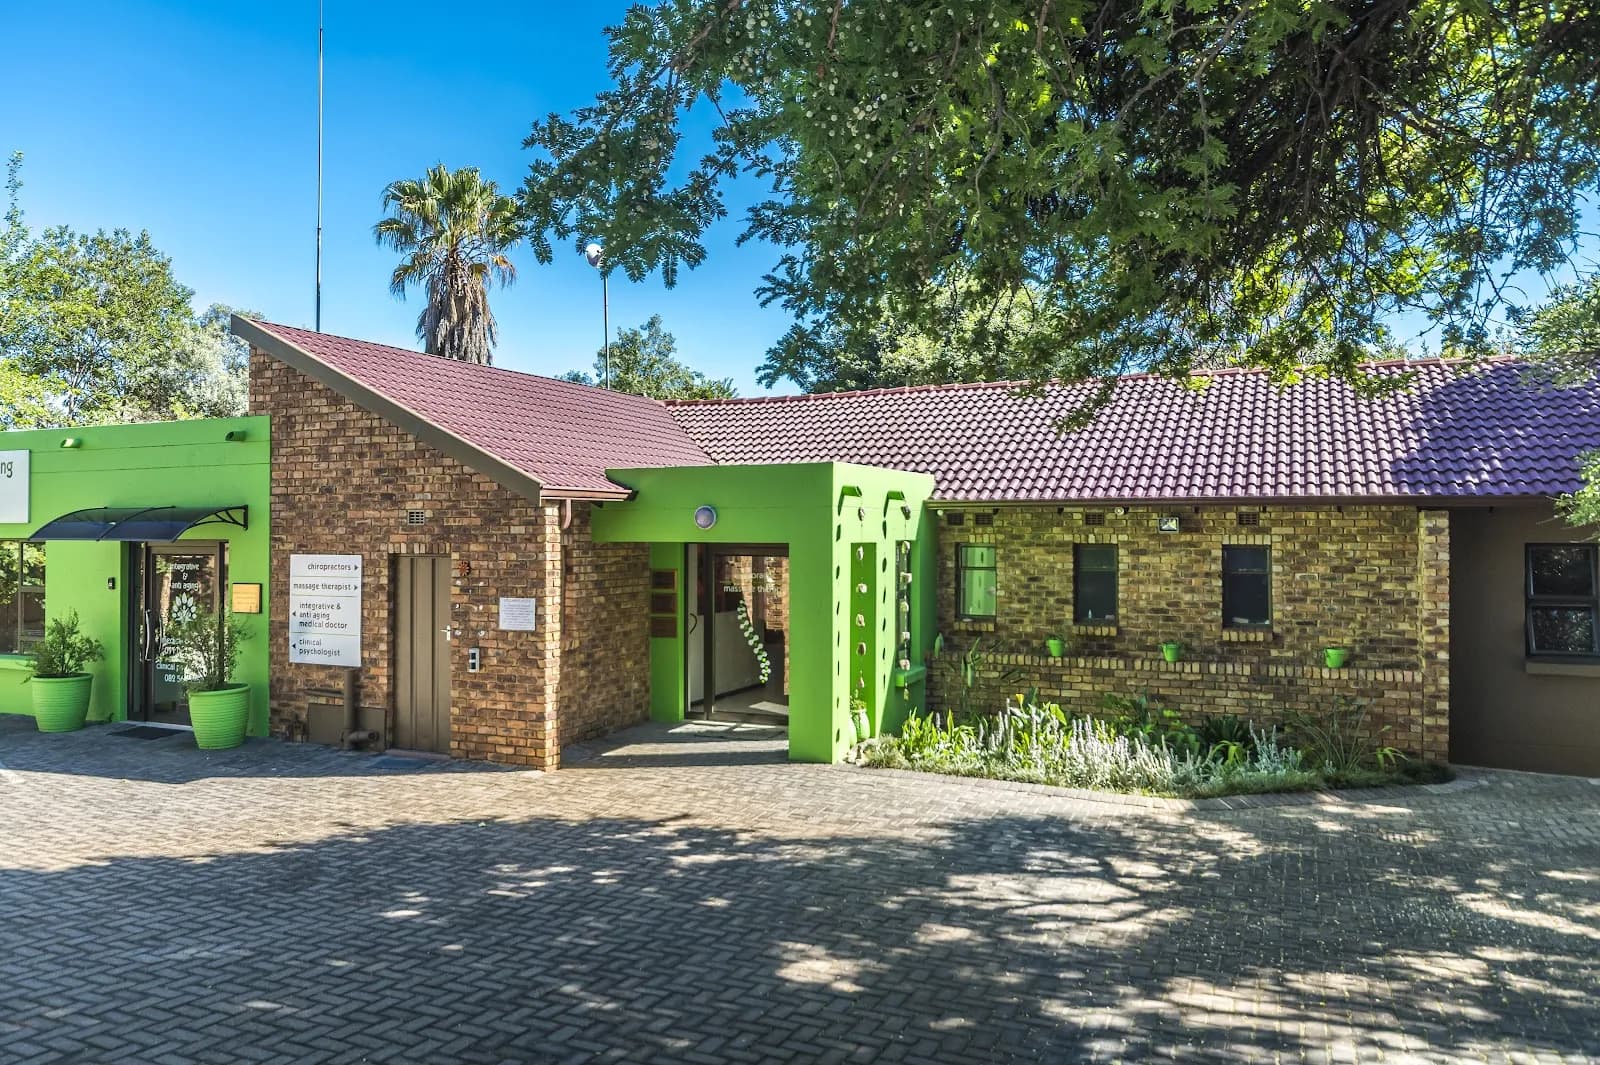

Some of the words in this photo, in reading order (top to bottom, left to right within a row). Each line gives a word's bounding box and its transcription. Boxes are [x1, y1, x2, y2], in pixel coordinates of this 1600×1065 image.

[307, 563, 351, 571] chiropractors
[321, 583, 351, 591] therapist
[299, 602, 335, 611] integrative
[312, 612, 330, 620] aging
[299, 620, 324, 628] medical
[324, 621, 348, 629] doctor
[299, 648, 341, 657] psychologist
